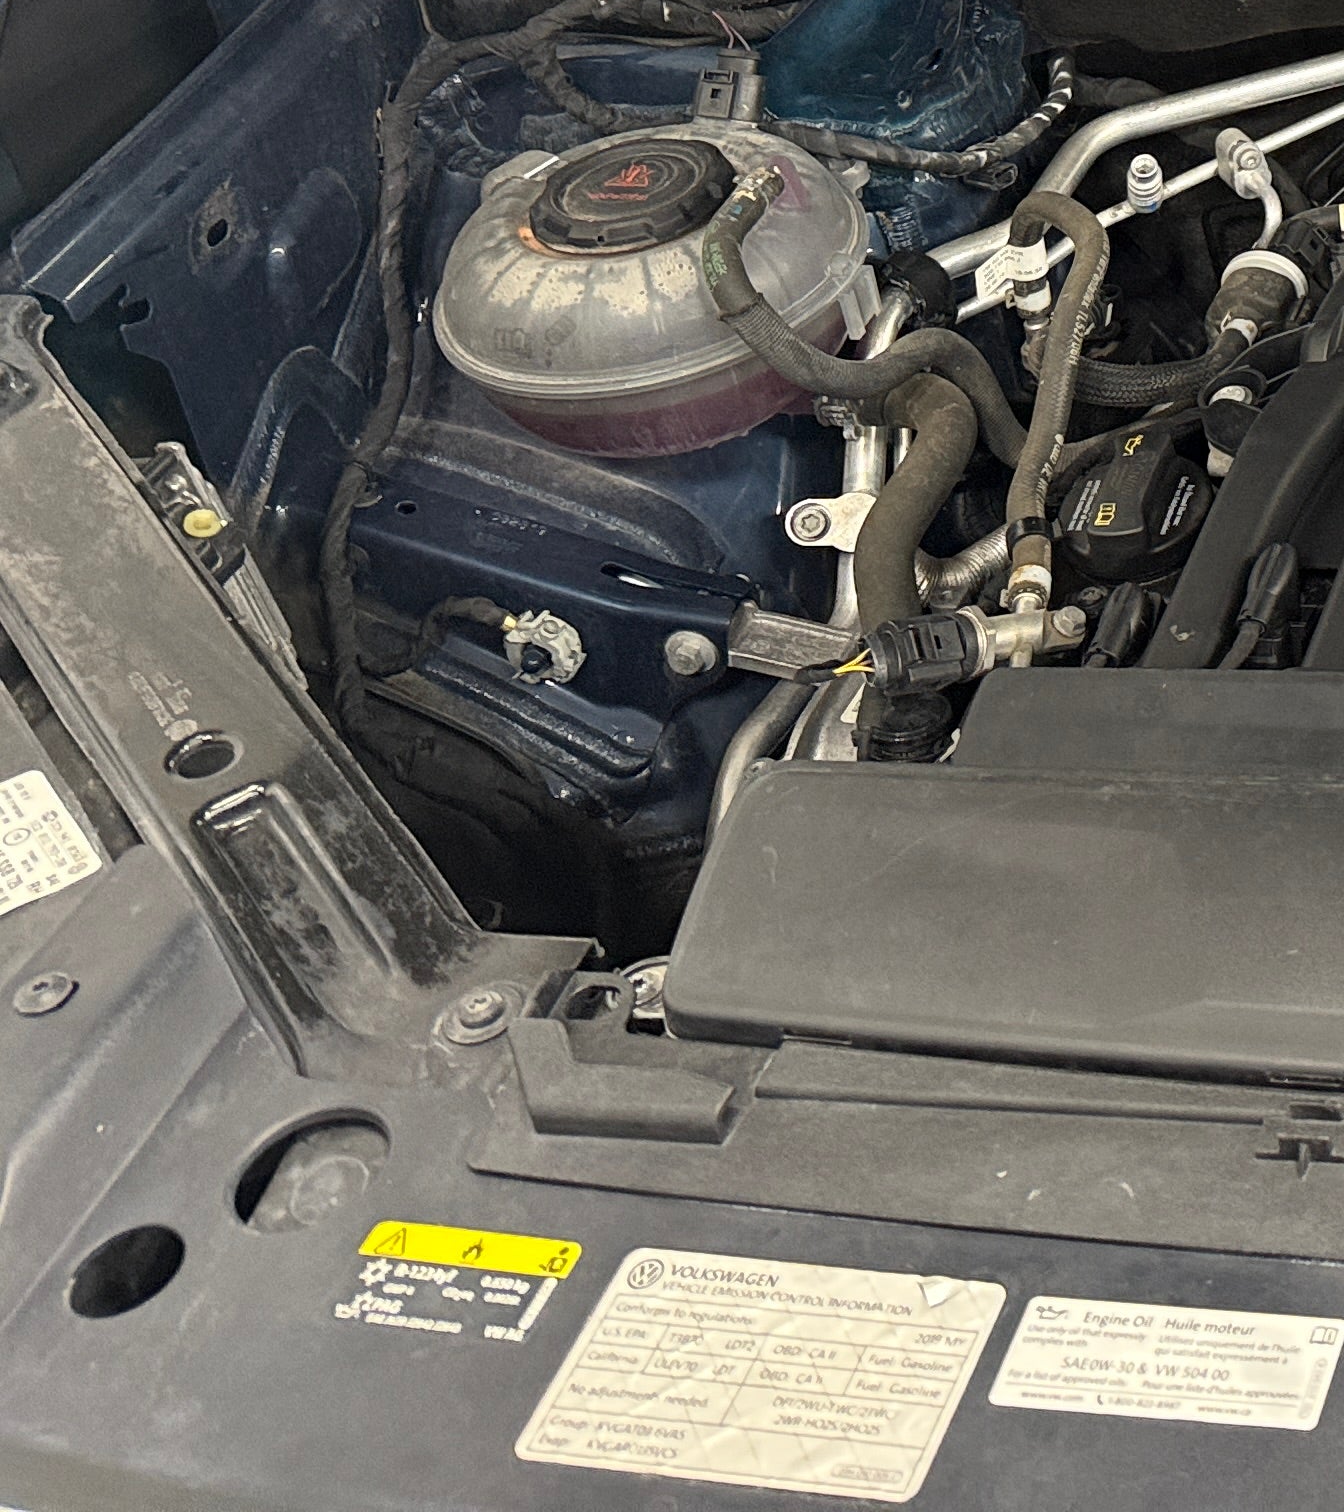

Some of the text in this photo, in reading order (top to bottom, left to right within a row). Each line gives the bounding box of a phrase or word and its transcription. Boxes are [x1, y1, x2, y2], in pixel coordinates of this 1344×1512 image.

[671, 1263, 780, 1288] VOLKSWAGEN
[662, 1280, 914, 1317] VEHICLE EMISSION CONTROL INFORMATION
[1083, 1310, 1155, 1329] Engine Oil
[1164, 1317, 1256, 1337] Huile moteur
[901, 1356, 956, 1373] Gasoline
[1061, 1355, 1090, 1370] SAE
[1137, 1362, 1149, 1376] &
[1155, 1363, 1181, 1378] VW
[1182, 1365, 1209, 1380] 504
[1211, 1367, 1231, 1382] 00
[888, 1381, 942, 1399] Gasoline
